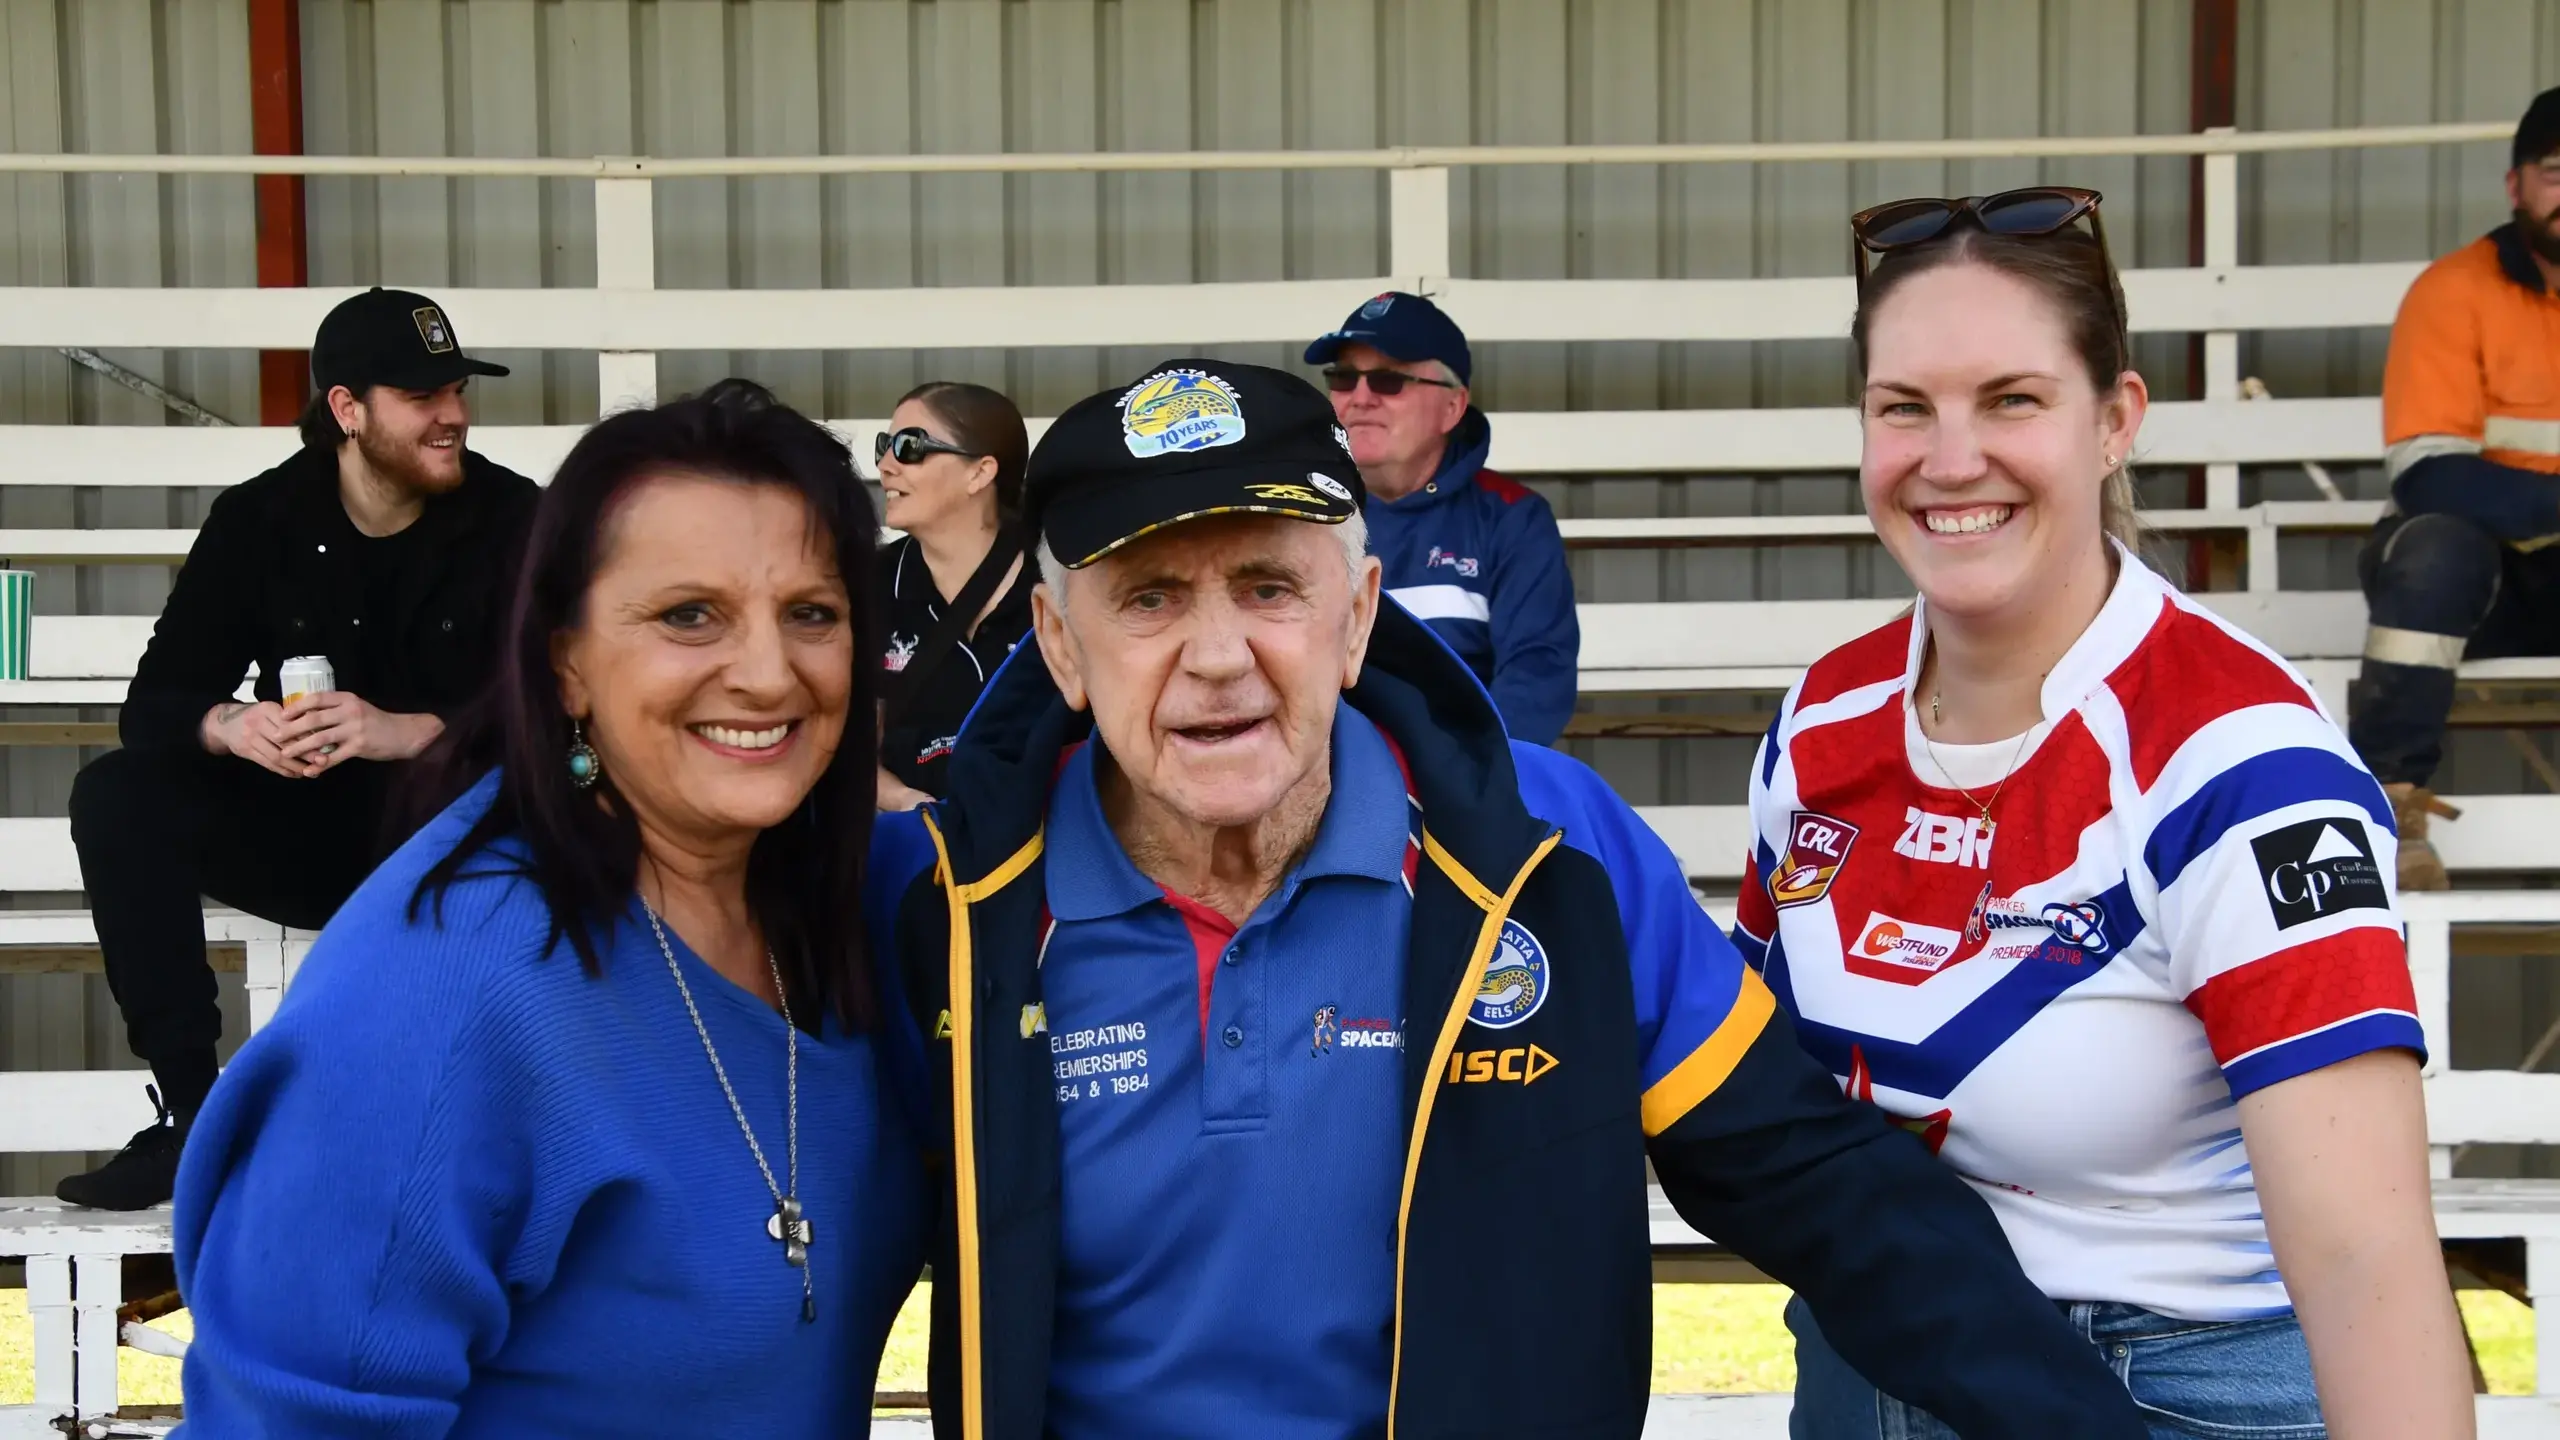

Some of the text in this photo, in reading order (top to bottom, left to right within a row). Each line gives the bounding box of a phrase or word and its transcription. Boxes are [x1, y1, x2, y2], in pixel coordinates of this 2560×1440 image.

[1156, 419, 1218, 449] 70 YEARS
[1797, 821, 1842, 858] CRL
[1892, 805, 1998, 870] ZBR
[2270, 860, 2331, 913] Cp
[1987, 897, 2026, 913] PARKES
[1529, 962, 1541, 972] 47
[1989, 945, 2084, 966] PREMIERS 2018
[1483, 1004, 1513, 1019] EELS
[1050, 1021, 1147, 1054] ELEBRATING
[1340, 1030, 1405, 1049] SPACEM
[1448, 1048, 1526, 1084] ISC
[1089, 1080, 1101, 1098] &
[1110, 1072, 1150, 1095] 1984
